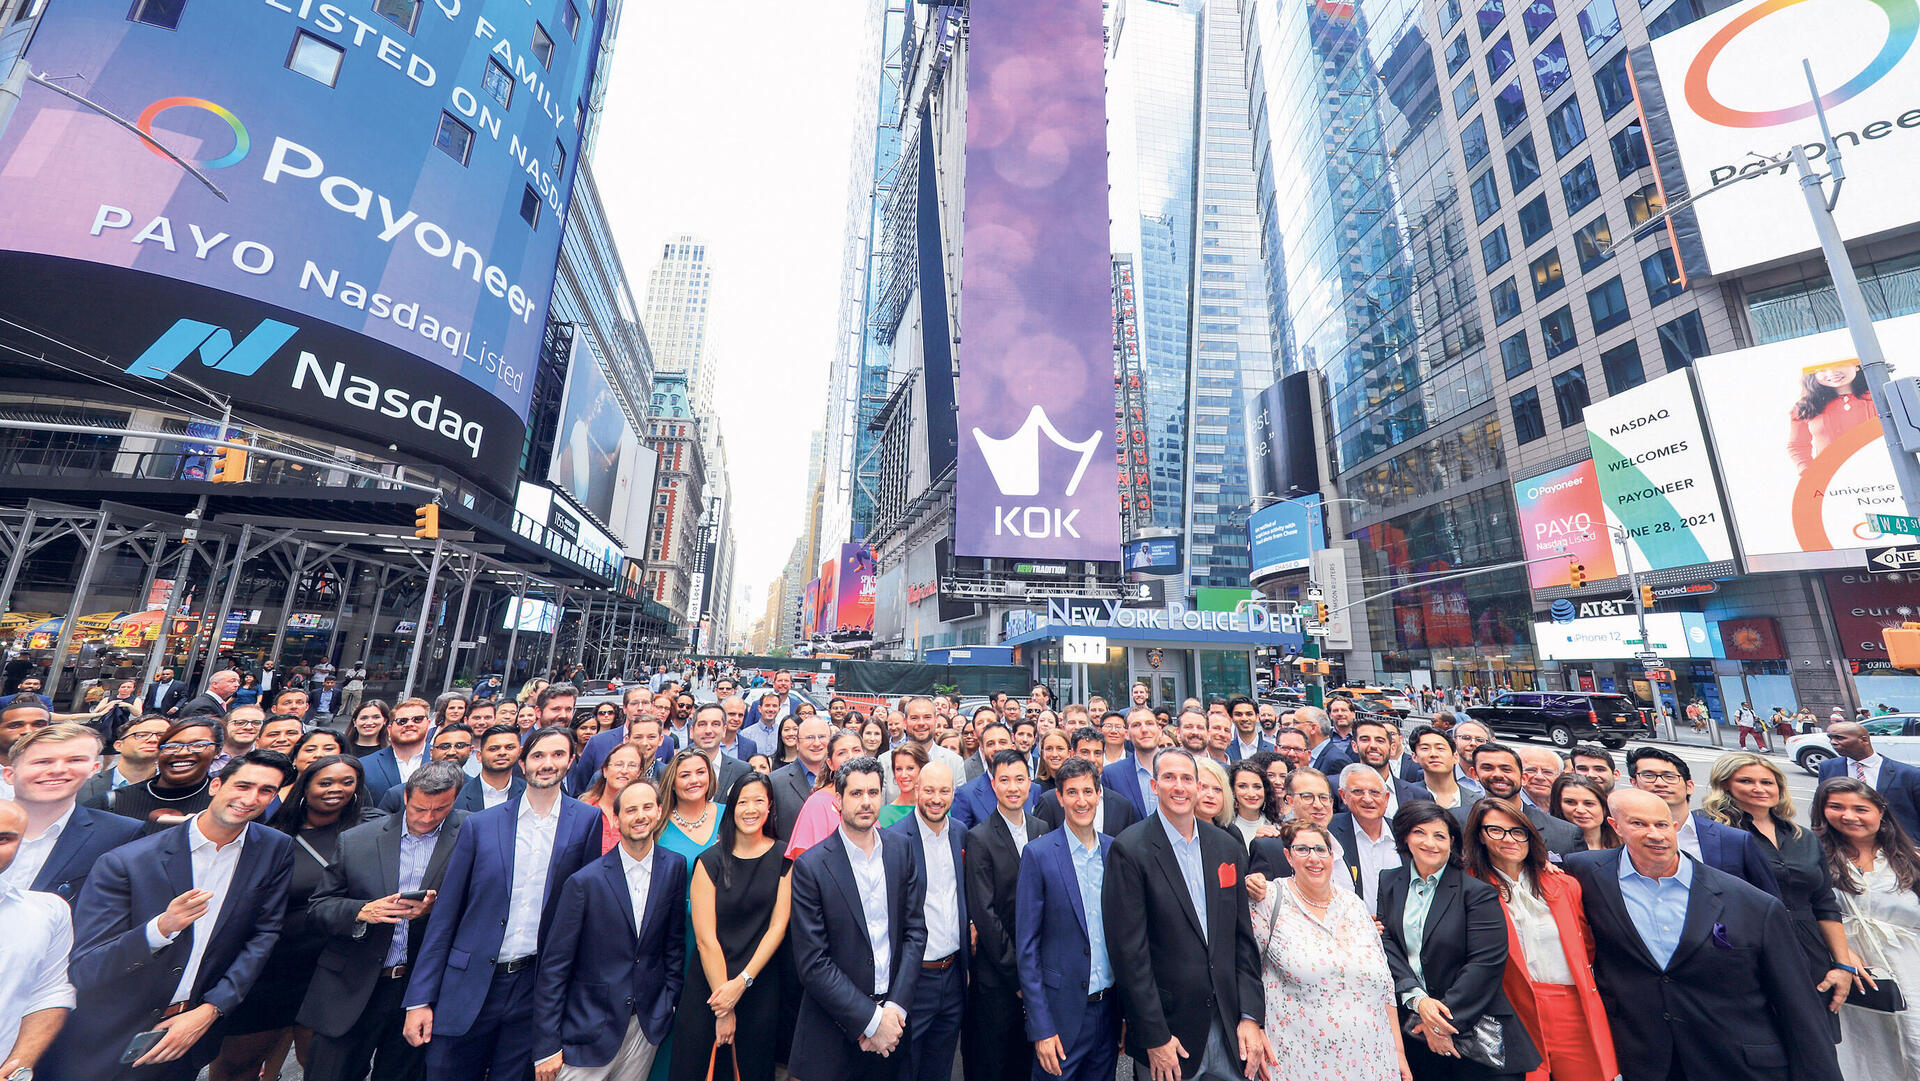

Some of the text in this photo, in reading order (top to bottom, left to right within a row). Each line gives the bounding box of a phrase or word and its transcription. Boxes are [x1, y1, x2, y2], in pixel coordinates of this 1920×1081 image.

[474, 15, 564, 129] FAMILY
[451, 86, 501, 140] ON
[89, 204, 275, 275] PAYO
[262, 136, 535, 324] Payoneer
[291, 350, 484, 458] Nasdaq
[1610, 409, 1670, 437] NASDAQ
[1608, 441, 1688, 472] WELCOMES
[1539, 476, 1584, 496] Payoneer
[1618, 478, 1694, 505] PAYONEER
[1813, 484, 1895, 498] A universe
[1857, 496, 1895, 506] Now
[995, 506, 1080, 539] KOK
[1535, 512, 1591, 540] PAYO
[1654, 522, 1675, 534] 28,
[1680, 513, 1716, 528] 2021
[1880, 517, 1891, 531] W
[1896, 518, 1909, 532] 43
[1884, 551, 1918, 564] ONE
[1049, 598, 1100, 626] NEW
[1103, 600, 1161, 628] YORK
[1168, 602, 1240, 631] POLICE
[1248, 604, 1304, 633] DEPT
[1579, 600, 1625, 618] AT&T
[1573, 631, 1621, 643] iPhone 12
